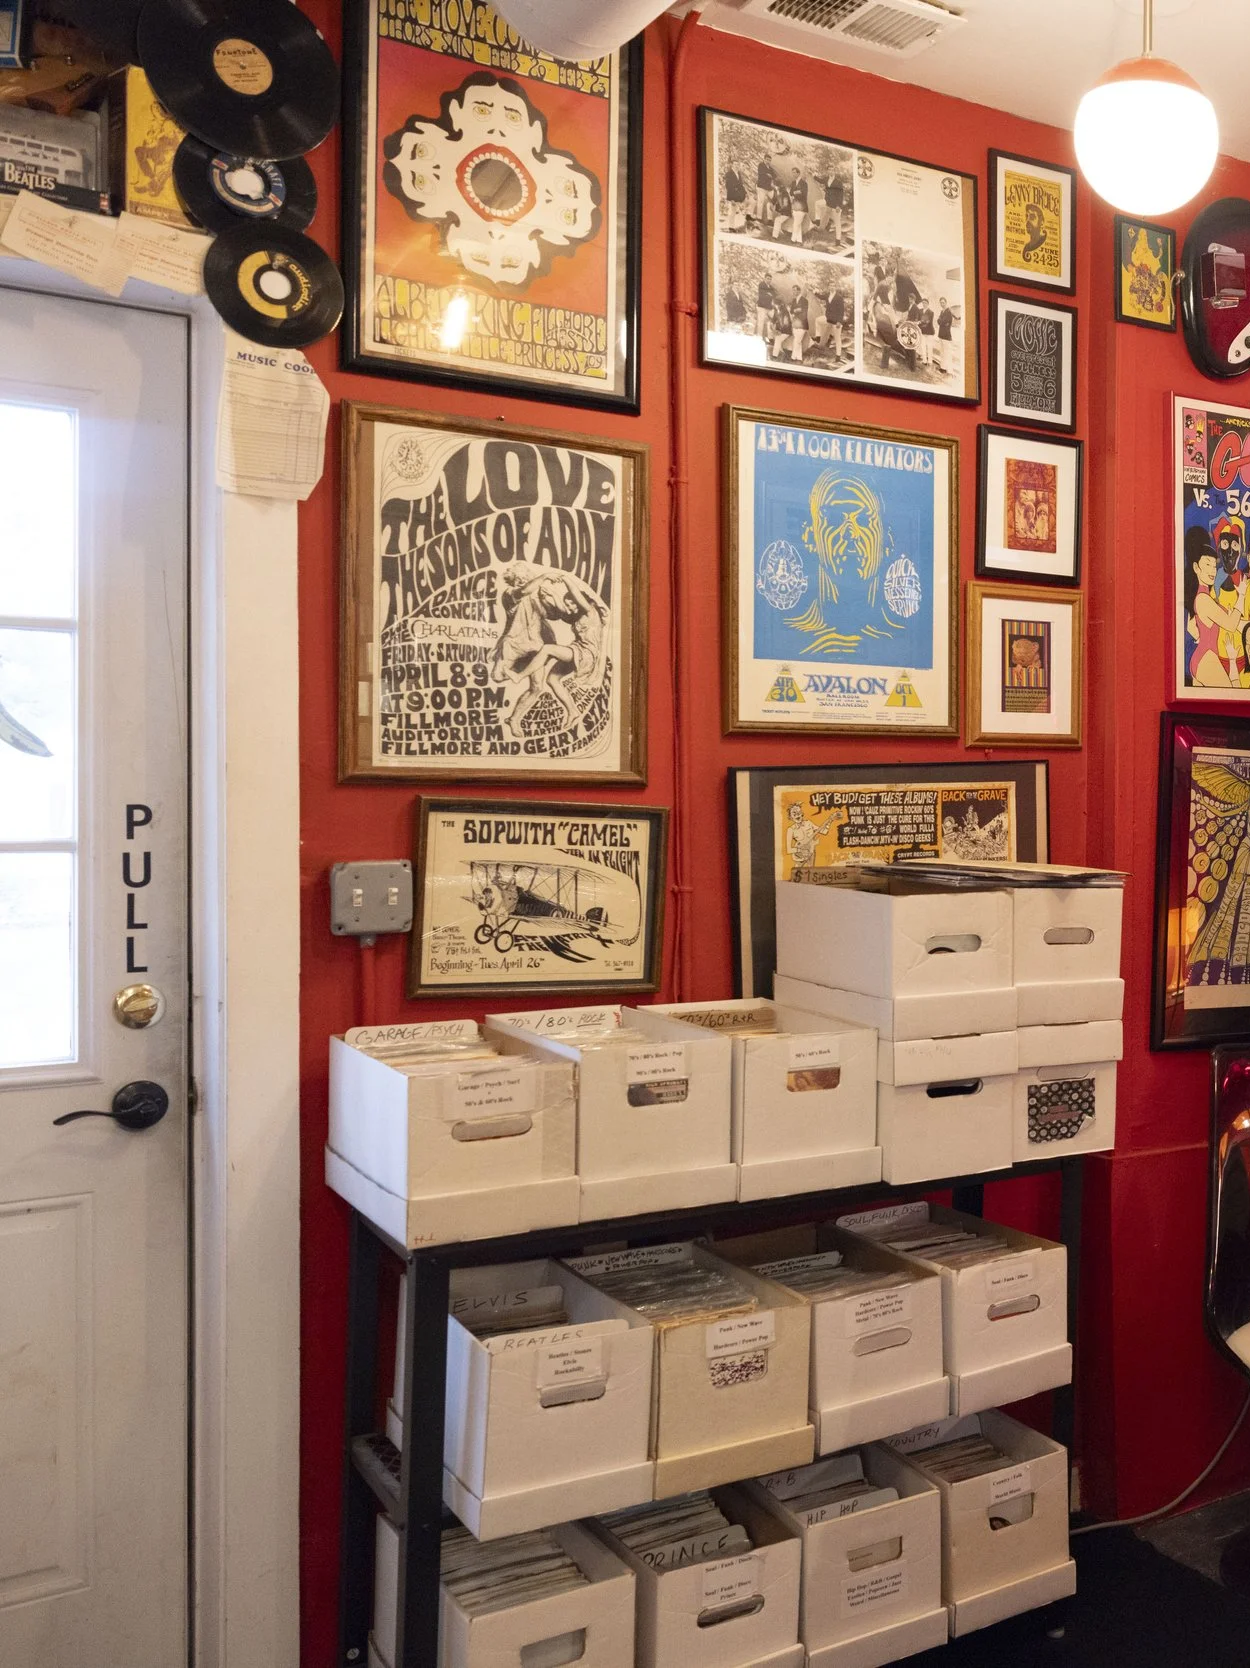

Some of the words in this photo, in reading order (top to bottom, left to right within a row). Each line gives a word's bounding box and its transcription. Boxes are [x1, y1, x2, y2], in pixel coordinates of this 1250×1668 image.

[4, 162, 56, 191] BEATLES
[1039, 246, 1059, 256] JUNE
[237, 351, 277, 367] MUSIC
[845, 440, 933, 474] ELEVATORS
[443, 441, 616, 529] LOVE
[432, 570, 498, 607] DANCE
[430, 600, 498, 624] CONCERT
[410, 619, 499, 642] CHARLATANS
[381, 643, 431, 667] FRIDAY
[437, 642, 491, 664] SATURDAY
[381, 662, 448, 695] APRIL
[803, 673, 890, 696] AVALON
[406, 688, 462, 712] 9:00
[380, 708, 500, 730] FILLMORE
[381, 724, 504, 742] AUDITORIUM
[381, 740, 482, 756] FILLMORE
[487, 740, 521, 756] AND
[523, 723, 580, 755] GEARY
[812, 792, 830, 806] HEY
[858, 793, 877, 805] GET
[878, 792, 903, 804] THESE
[903, 791, 937, 804] ALBUMS!
[942, 790, 966, 801] BACK
[977, 789, 1007, 801] GRAVE
[441, 820, 455, 828] THE
[463, 819, 556, 846] SOPWITH
[122, 803, 153, 974] PULL
[452, 1291, 528, 1313] ELVIS
[807, 1509, 827, 1527] HIP
[839, 1500, 858, 1516] HOP
